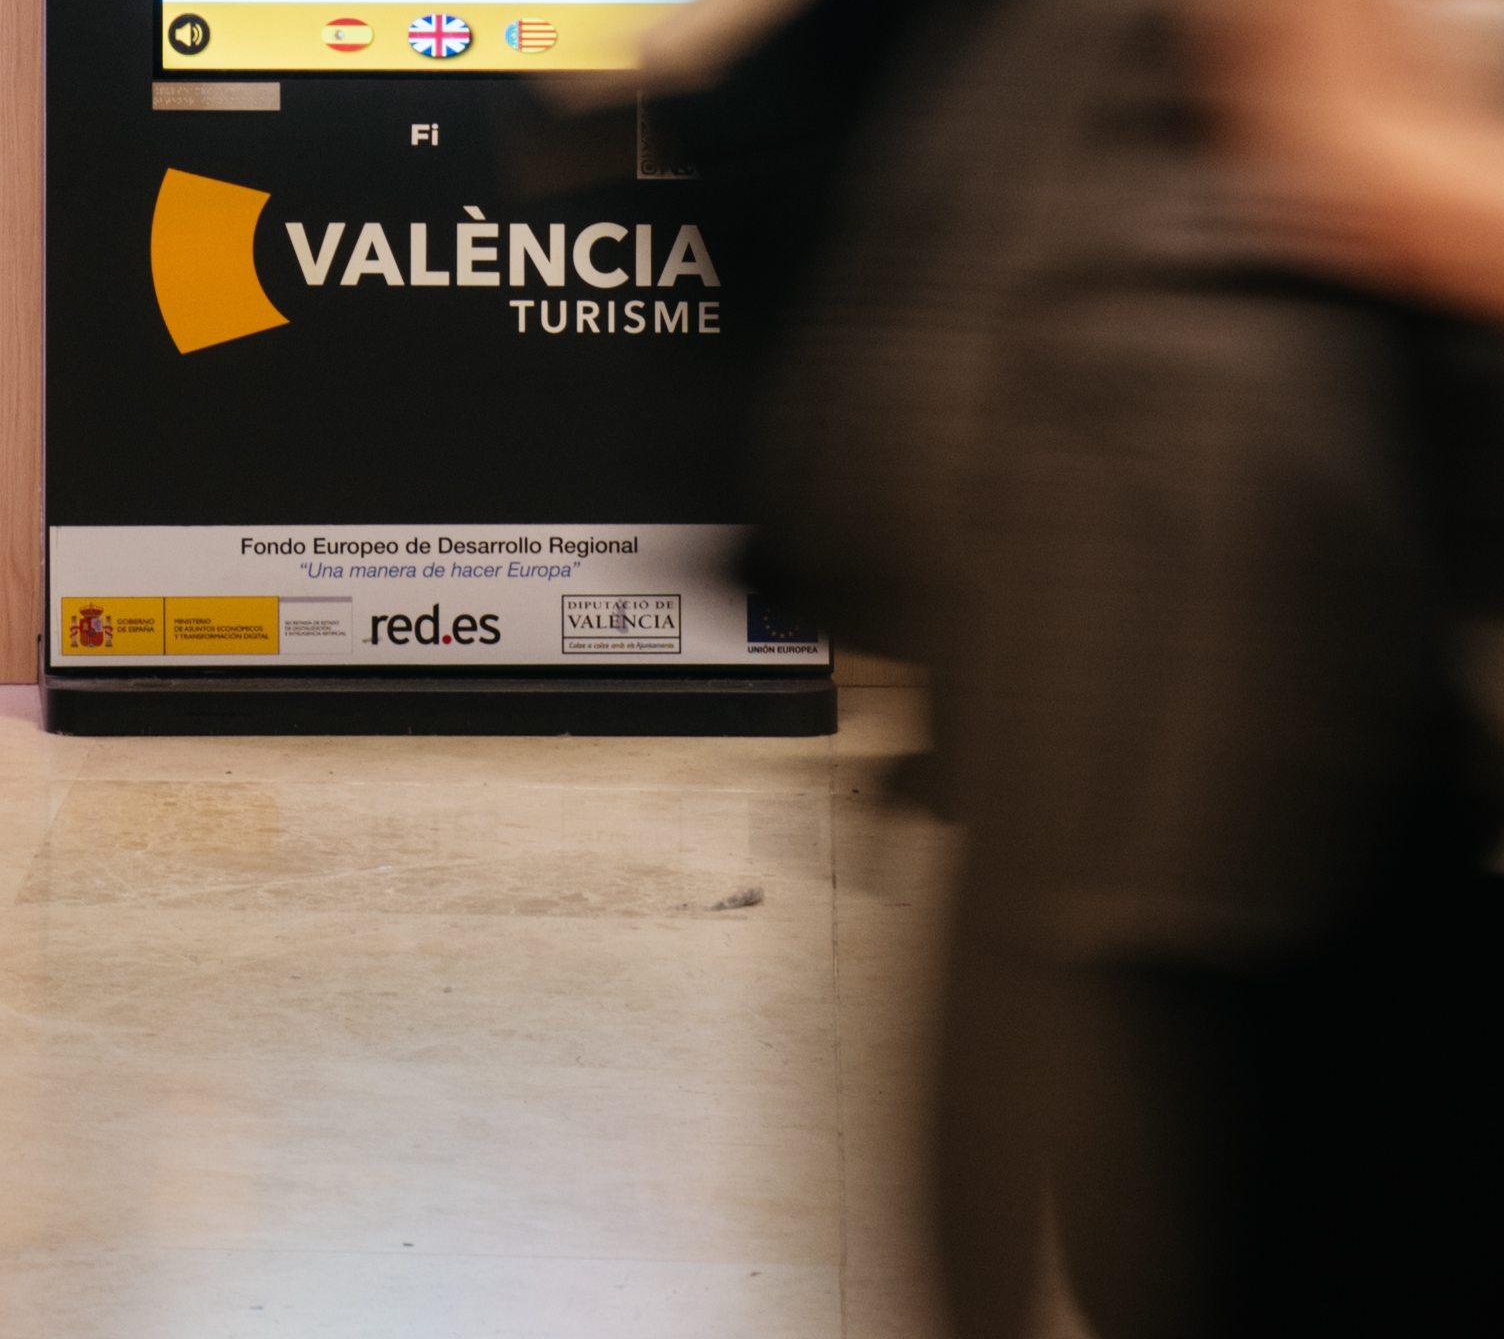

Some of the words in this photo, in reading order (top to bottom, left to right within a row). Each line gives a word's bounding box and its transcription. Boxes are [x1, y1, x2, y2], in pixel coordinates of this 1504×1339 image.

[410, 124, 439, 146] Fi
[285, 206, 722, 287] VALÈNCIA
[509, 300, 721, 334] TURISME
[241, 537, 306, 556] Fondo
[314, 537, 398, 560] Europeo
[406, 537, 430, 556] de
[439, 537, 542, 556] Desarrollo
[549, 537, 638, 560] Regional
[350, 565, 416, 579] manera
[421, 562, 446, 579] de
[451, 562, 502, 579] hacer
[568, 600, 649, 610] DIPUTACIÓ
[655, 601, 674, 610] DE
[128, 625, 155, 633] ESPAÑA
[370, 603, 501, 647] red.es
[748, 645, 776, 654] UNIÓN
[777, 646, 818, 654] EUROPEA
